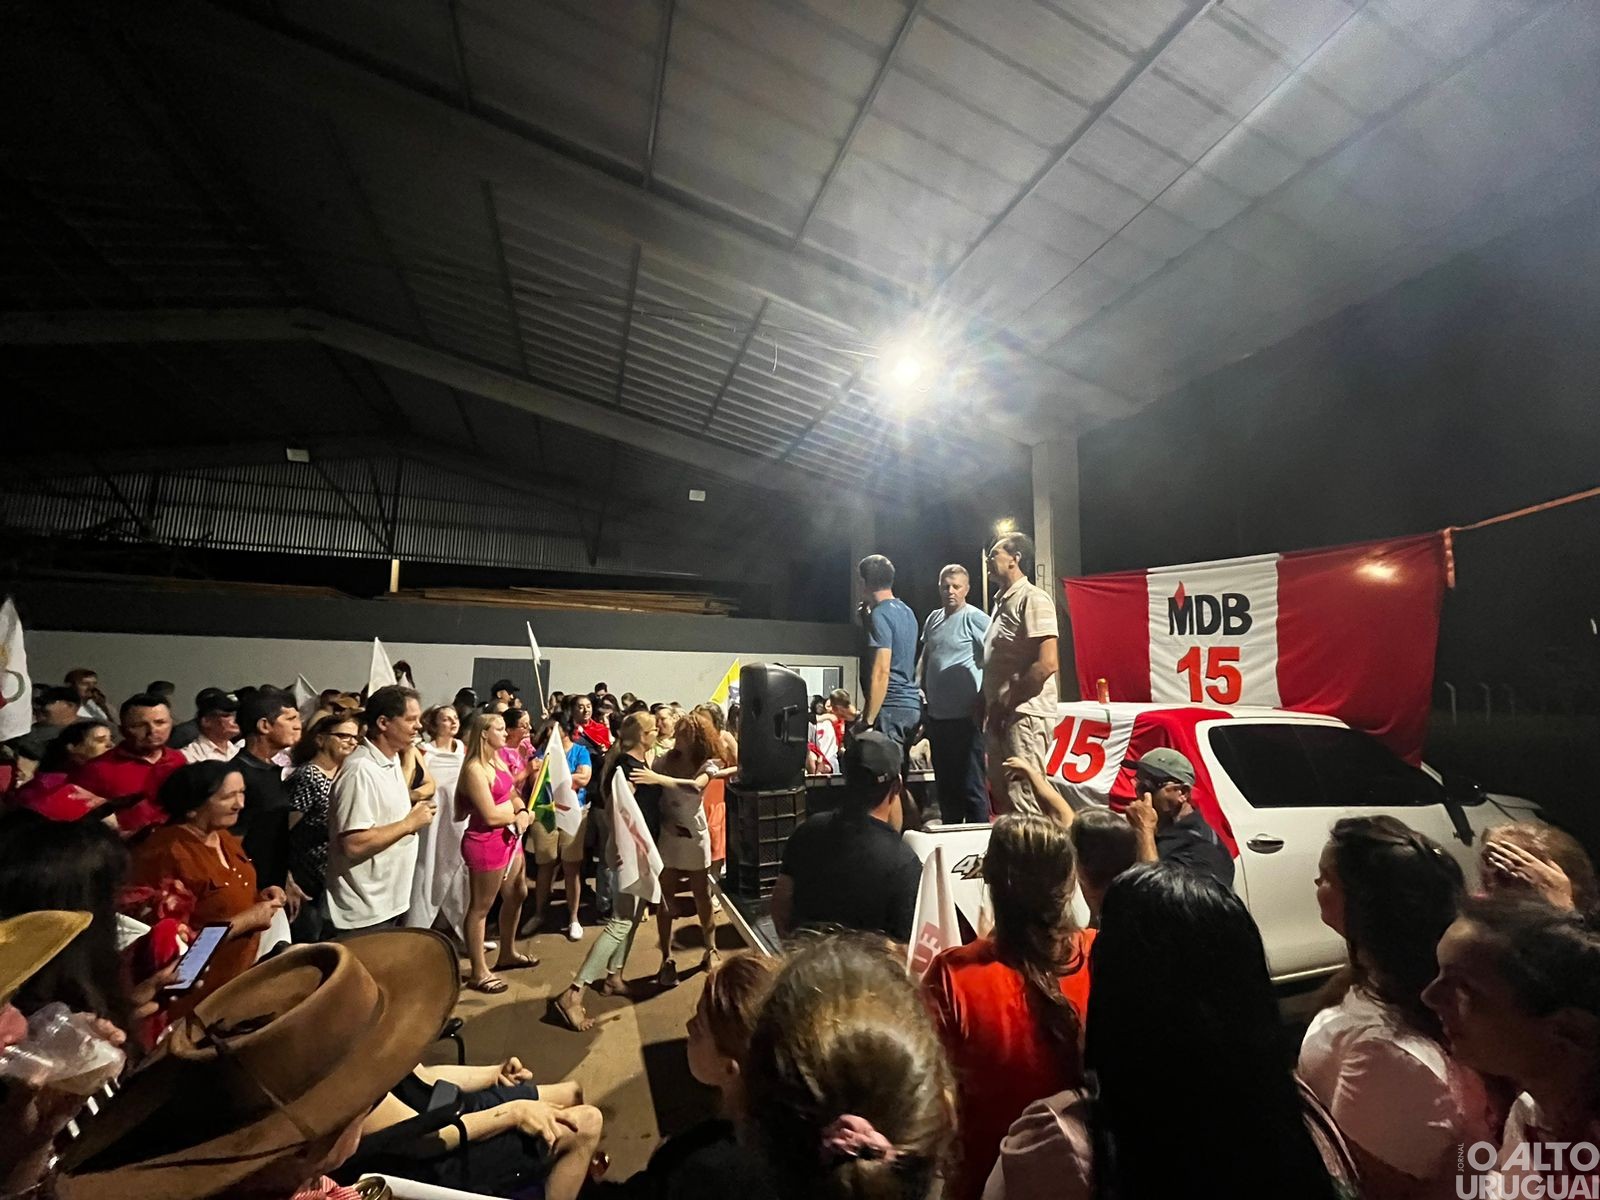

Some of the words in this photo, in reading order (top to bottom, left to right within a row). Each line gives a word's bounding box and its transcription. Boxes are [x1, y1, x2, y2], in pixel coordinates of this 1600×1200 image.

[1168, 592, 1253, 636] MDB
[1177, 646, 1242, 705] 15
[1046, 715, 1112, 784] 15
